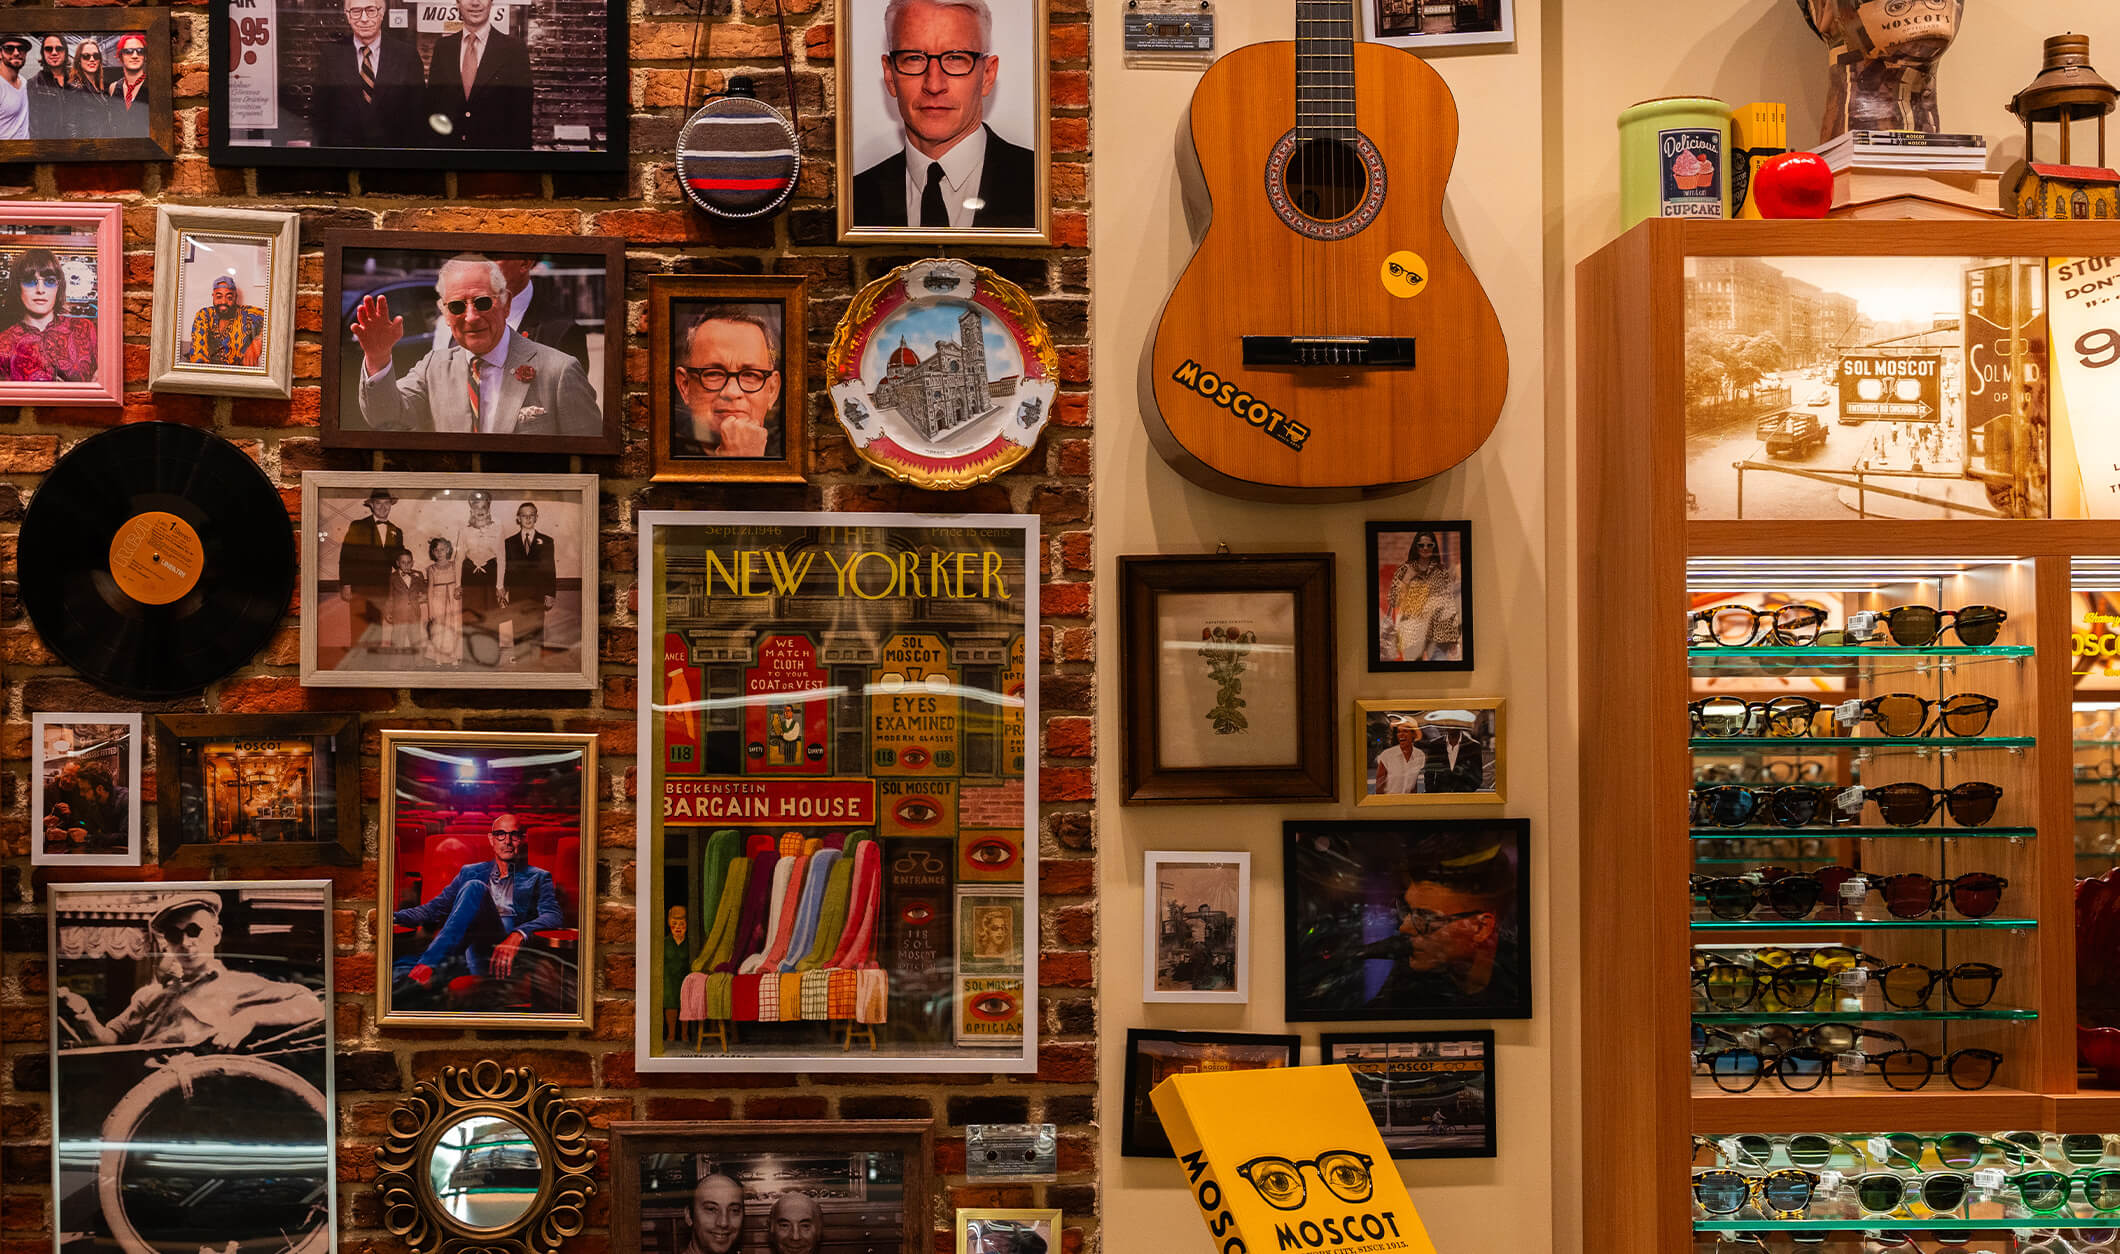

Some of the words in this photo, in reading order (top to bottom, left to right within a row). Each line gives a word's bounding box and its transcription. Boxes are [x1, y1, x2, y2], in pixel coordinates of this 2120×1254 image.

[1664, 134, 1718, 157] Delicious
[1664, 204, 1721, 216] CUPCAKE
[2065, 274, 2120, 299] DON'
[1844, 360, 1871, 375] SOL
[1875, 360, 1936, 376] MOSCOT
[1174, 361, 1285, 432] MOSCOT
[706, 549, 816, 597] NEW
[824, 550, 1012, 600] YORKER
[776, 639, 795, 648] WE
[902, 637, 924, 649] SOL
[766, 649, 810, 657] MATCH
[886, 650, 941, 662] MOSCOT
[773, 658, 804, 670] CLOTH
[751, 679, 780, 690] COAT
[796, 679, 824, 690] VEST
[893, 697, 937, 713] EYES
[876, 716, 956, 731] EXAMINED
[234, 742, 282, 751] MOSCOT
[671, 746, 691, 761] 118
[877, 750, 895, 762] 118
[666, 783, 767, 795] BECKENSTEIN
[882, 782, 903, 794] SOL
[906, 782, 951, 795] MOSCOT
[664, 797, 770, 817] BARGAIN
[780, 798, 862, 817] HOUSE
[893, 876, 945, 885] ENTRANCE
[964, 980, 984, 992] SOL
[986, 980, 1024, 992] MOSCO
[1388, 1062, 1435, 1072] MOSCOT
[1275, 1212, 1401, 1251] MOSCOT
[1357, 1243, 1385, 1253] SINCE
